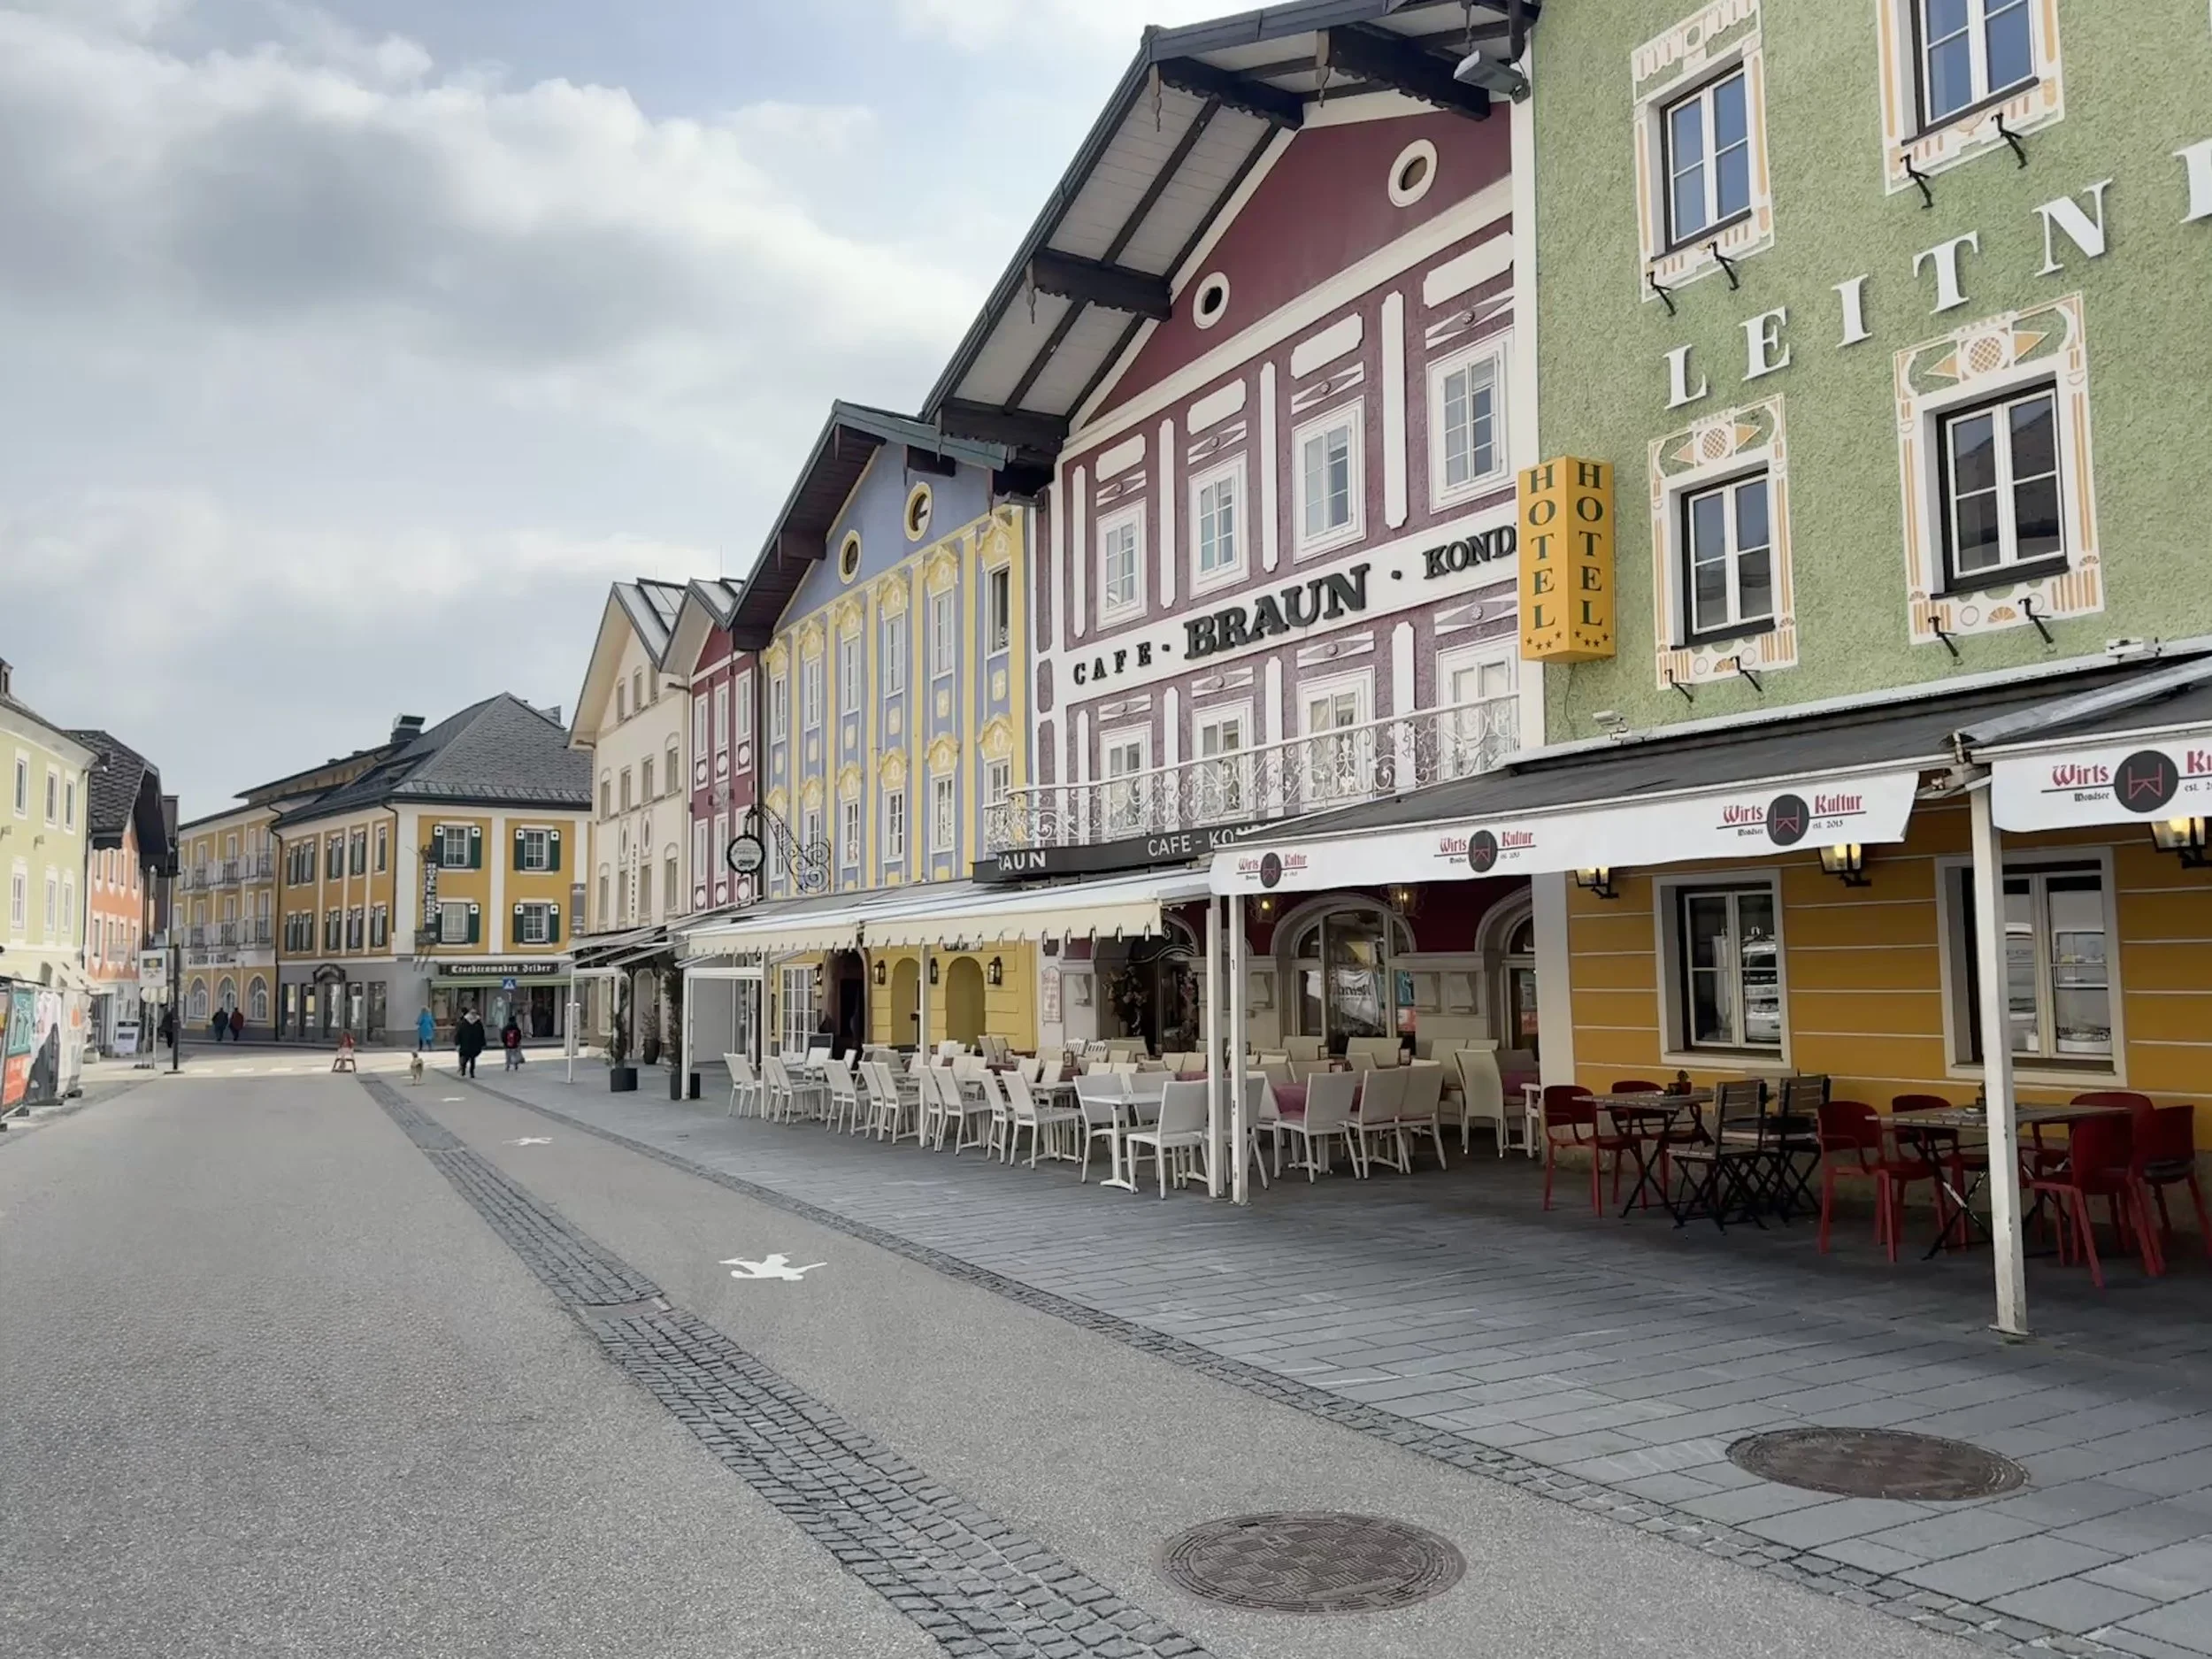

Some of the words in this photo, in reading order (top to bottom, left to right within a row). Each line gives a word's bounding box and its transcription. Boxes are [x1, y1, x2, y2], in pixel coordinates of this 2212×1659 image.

[1528, 464, 1556, 630] HOTEL
[1576, 461, 1603, 627] HOTEL
[1073, 641, 1151, 685] CAFE
[1183, 563, 1371, 659] BRAUN
[1422, 522, 1517, 580] KOND
[2052, 764, 2109, 787] Wirts
[1723, 804, 1763, 824] Wirts
[1815, 794, 1863, 815] Kultur
[1148, 833, 1192, 856] CAFE
[1440, 837, 1467, 853] Wirts
[1502, 830, 1533, 847] Kultur
